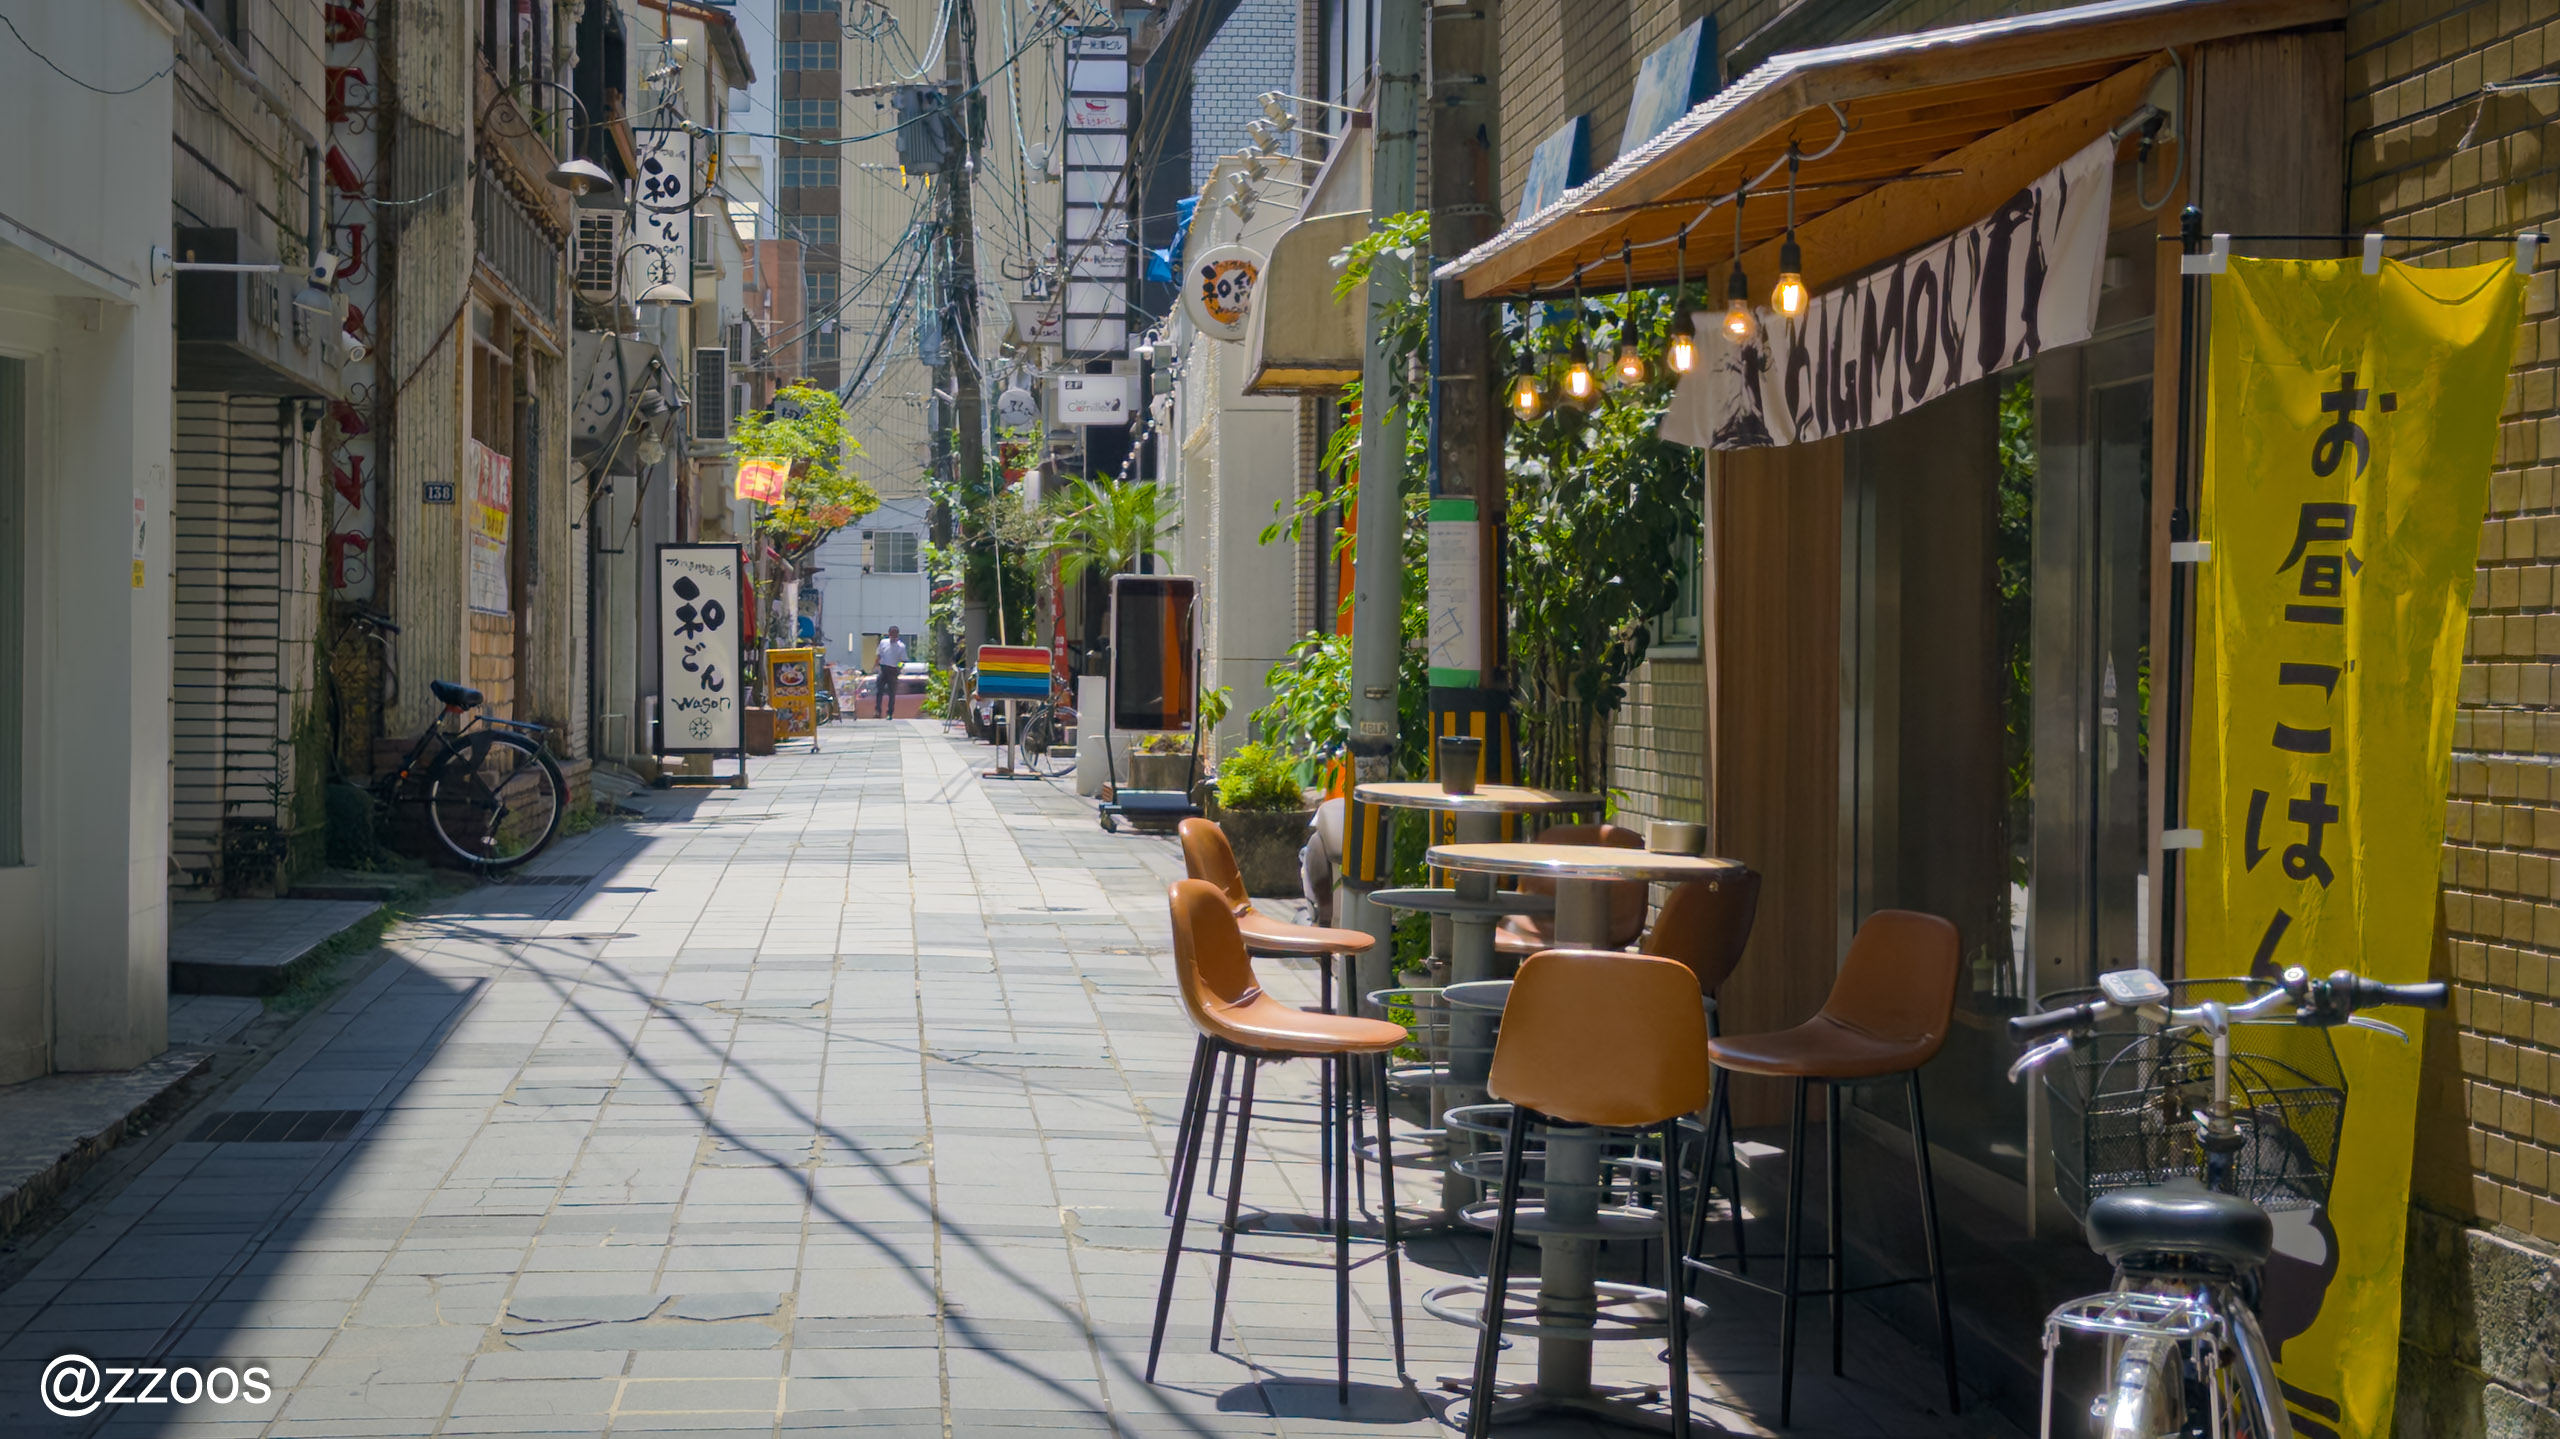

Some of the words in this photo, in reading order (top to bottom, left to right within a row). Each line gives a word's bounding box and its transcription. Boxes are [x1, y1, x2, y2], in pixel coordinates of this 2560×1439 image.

[428, 486, 451, 500] 138
[672, 575, 726, 693] 和ごん
